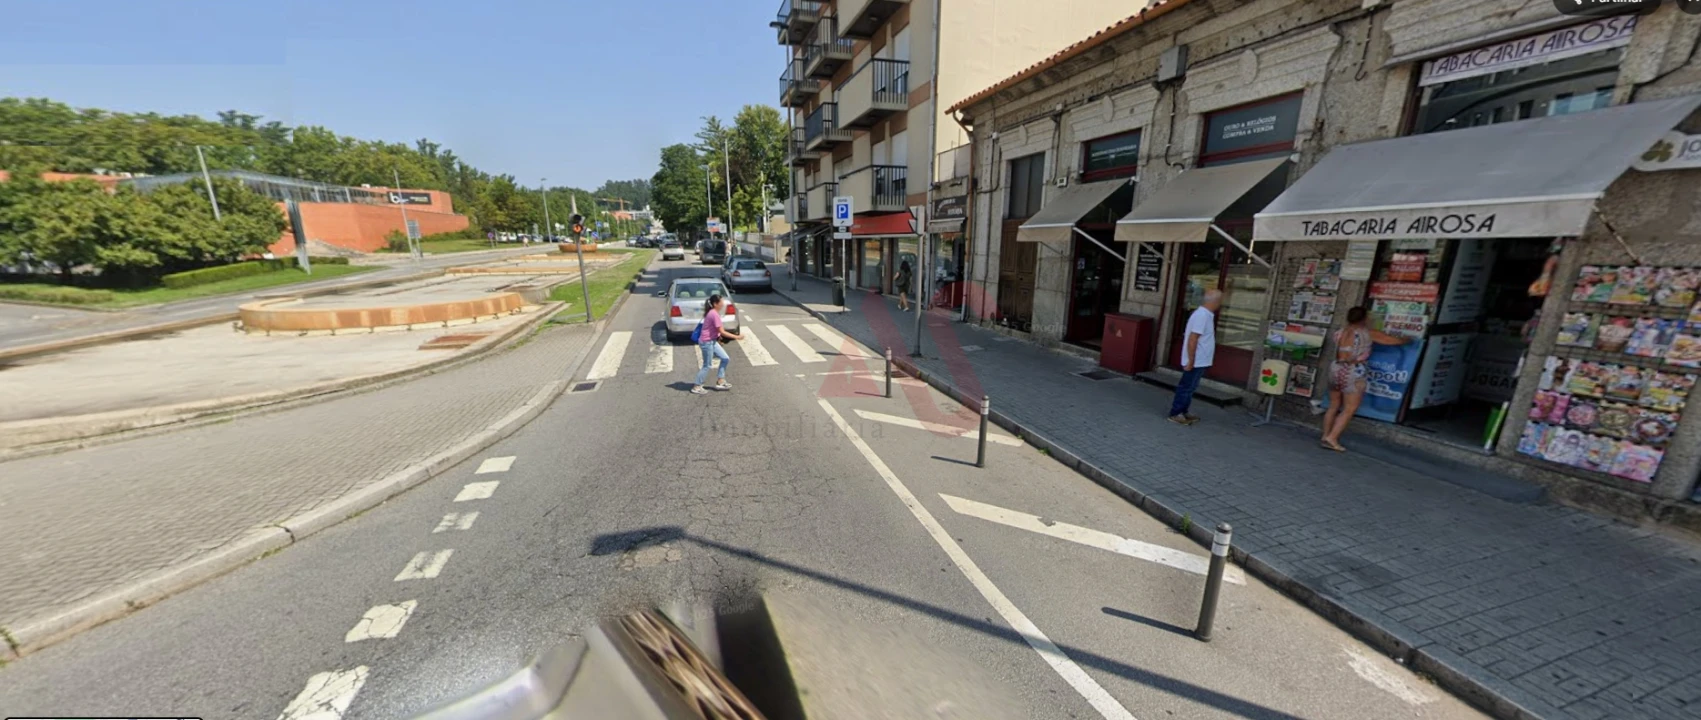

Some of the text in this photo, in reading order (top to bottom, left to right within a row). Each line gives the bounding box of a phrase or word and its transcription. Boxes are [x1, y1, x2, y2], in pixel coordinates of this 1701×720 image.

[1427, 15, 1639, 77] TABACARIA AIROSA
[1253, 125, 1274, 134] VENDA
[1302, 213, 1496, 236] TABACARIA AIROSA
